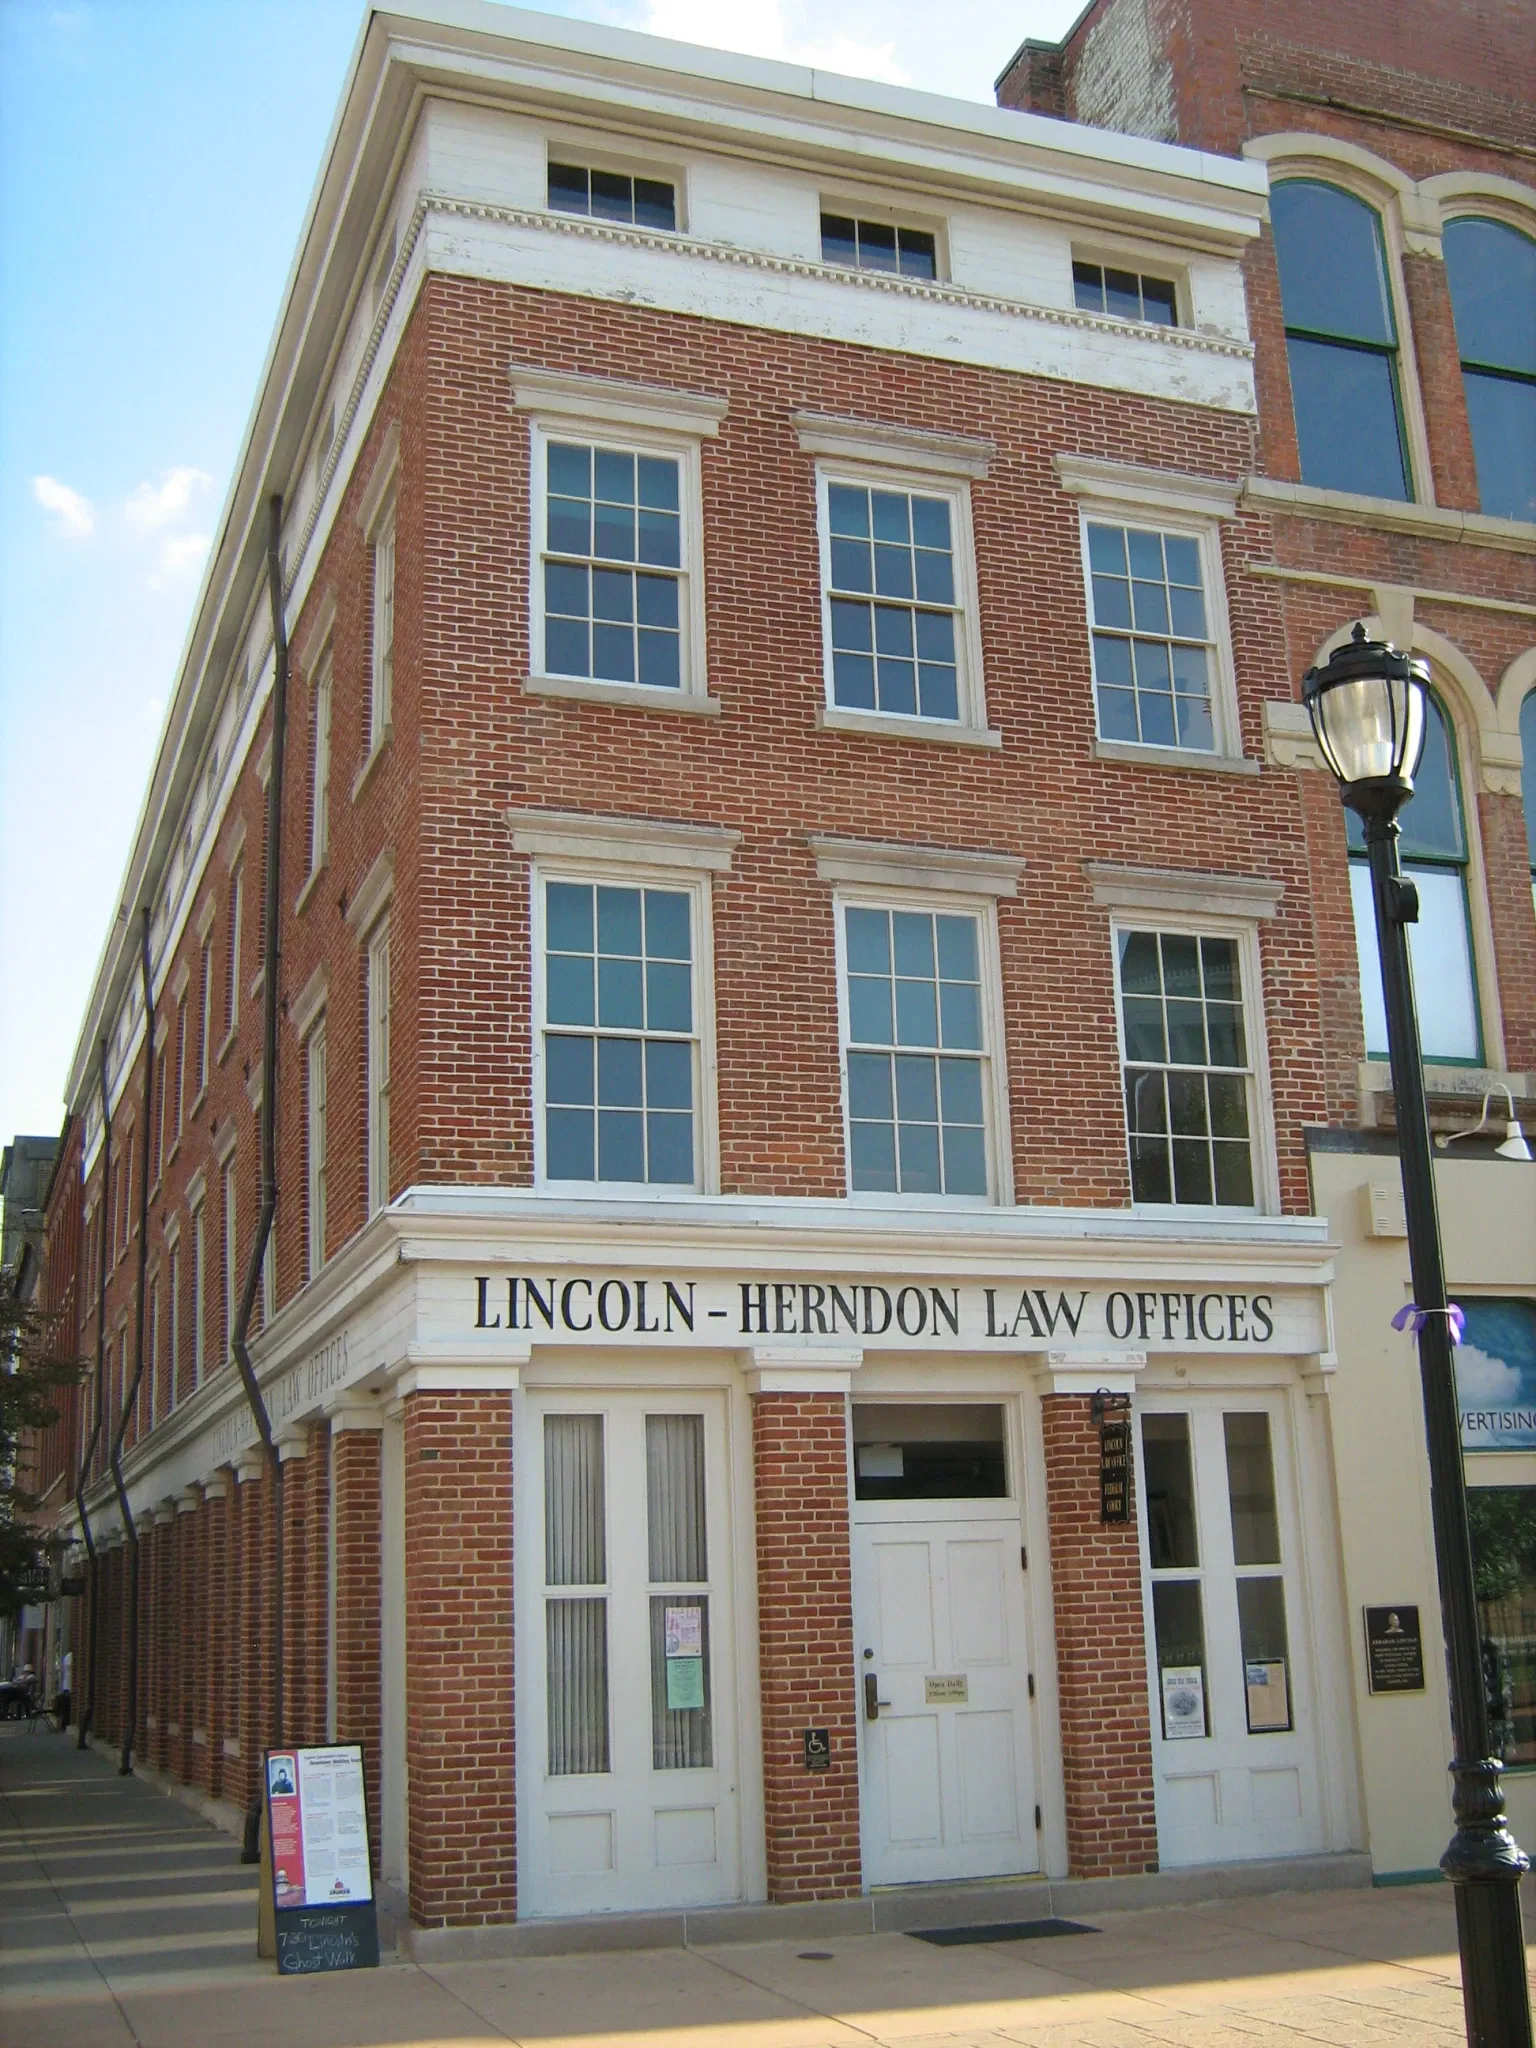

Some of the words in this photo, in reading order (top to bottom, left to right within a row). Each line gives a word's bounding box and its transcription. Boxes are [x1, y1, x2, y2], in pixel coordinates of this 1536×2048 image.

[985, 1289, 1090, 1338] LAW
[1106, 1291, 1273, 1343] OFFICES
[1458, 1411, 1536, 1431] VERTISIN
[300, 1915, 348, 1929] TONIGHT
[282, 1952, 324, 1970] Ghost
[325, 1950, 357, 1967] Walk
